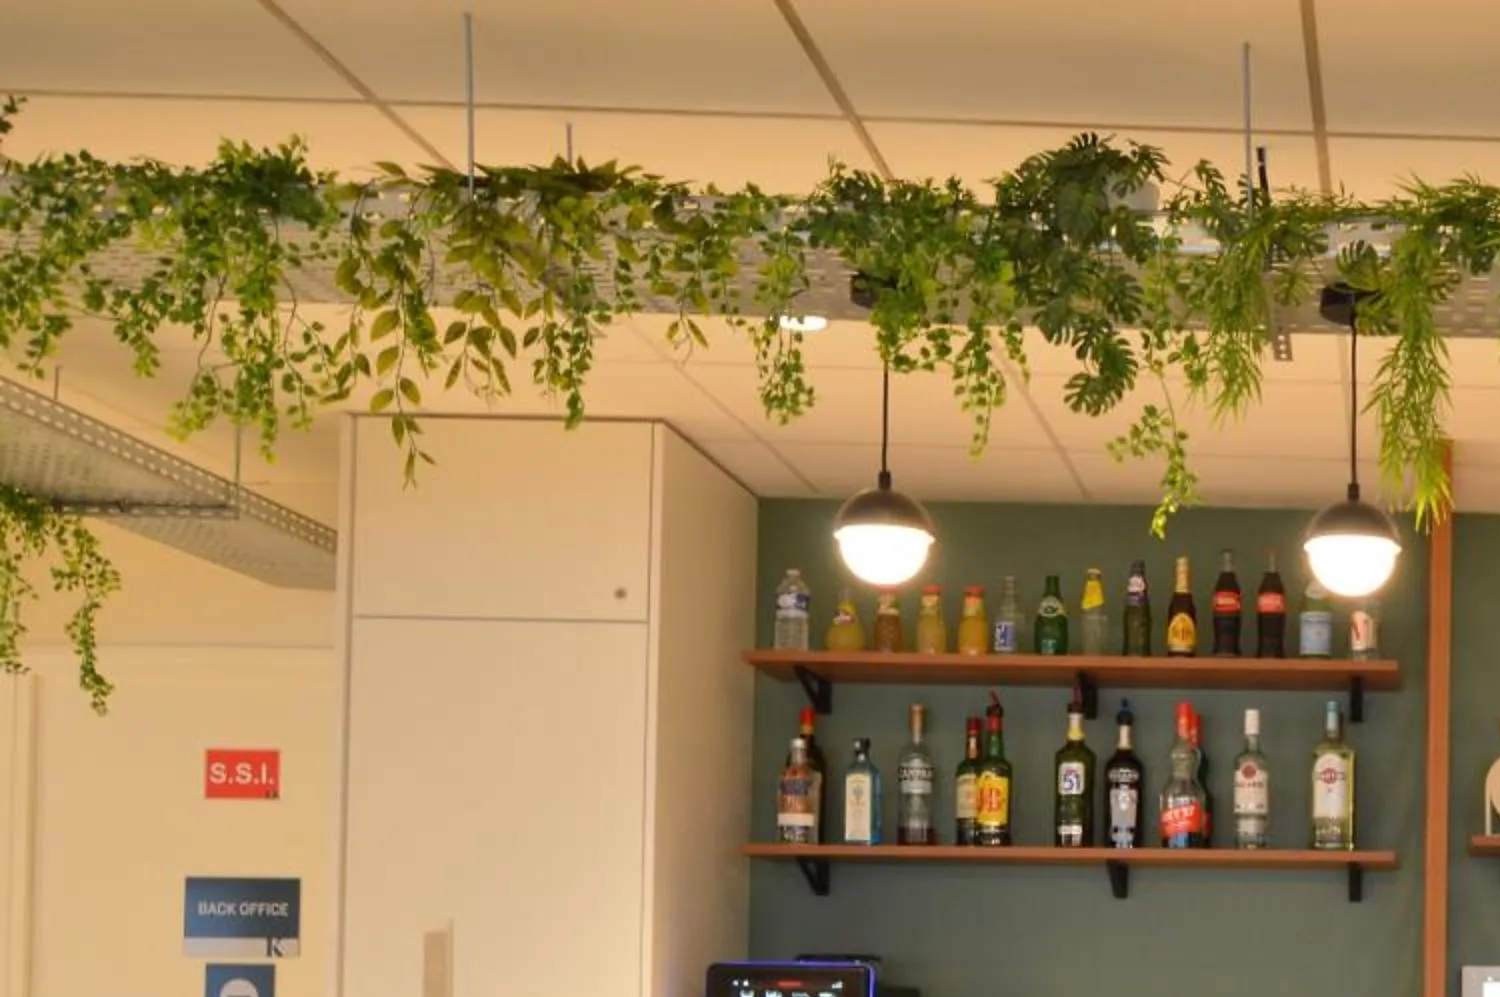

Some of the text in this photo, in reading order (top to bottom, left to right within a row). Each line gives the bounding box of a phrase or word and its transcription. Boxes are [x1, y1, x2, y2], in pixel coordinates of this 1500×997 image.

[209, 761, 275, 785] S.S.I.
[198, 901, 289, 917] BACK OFFICE
